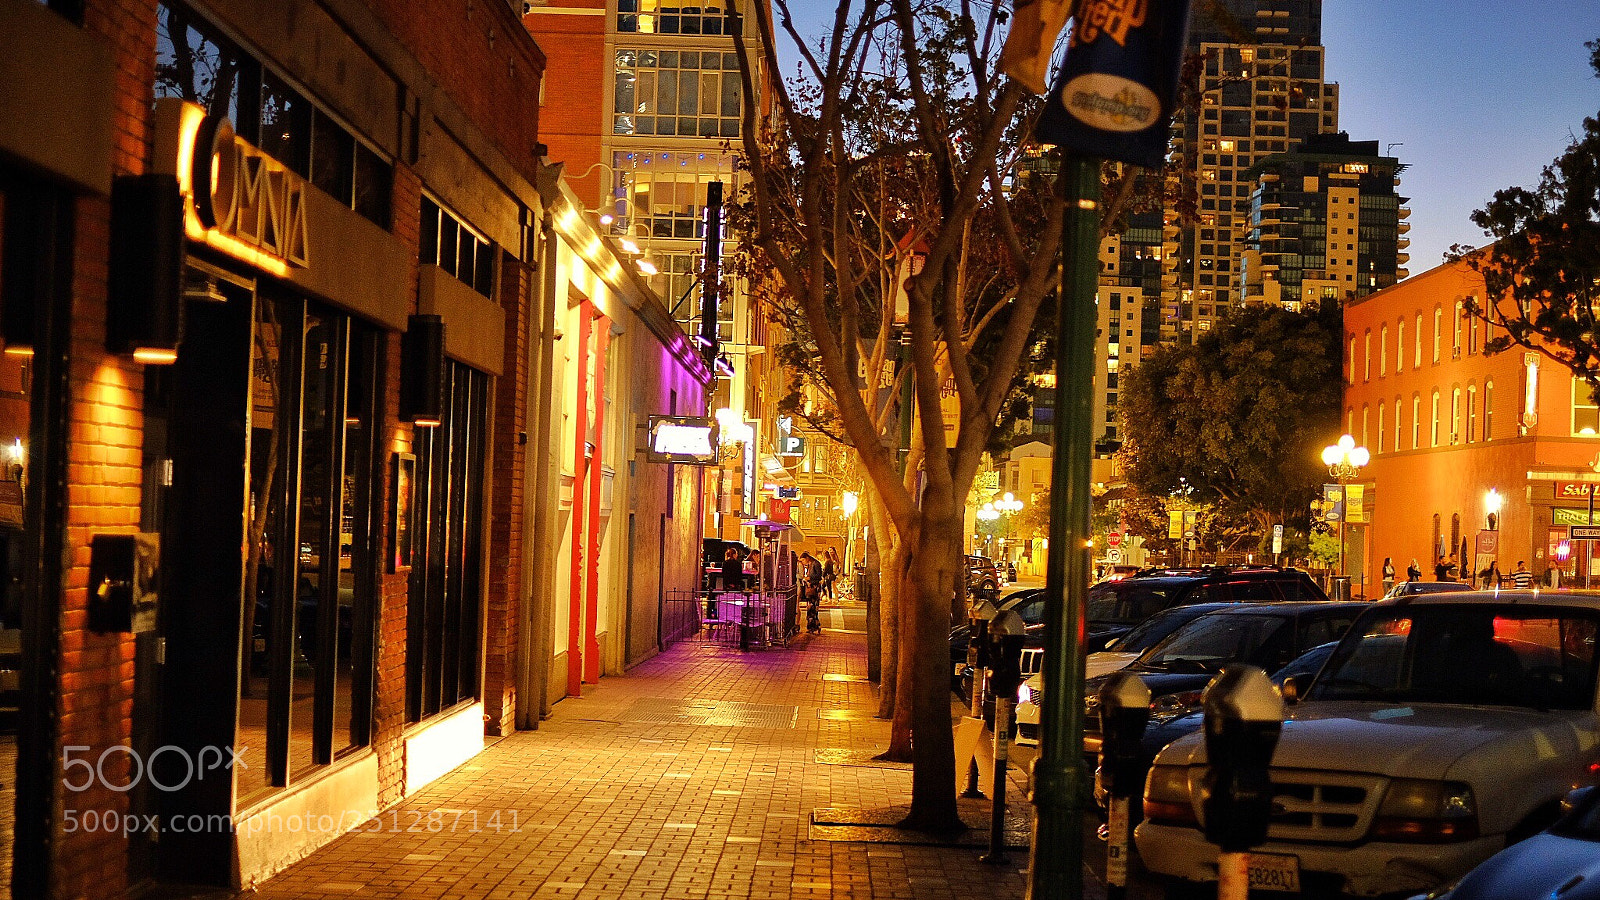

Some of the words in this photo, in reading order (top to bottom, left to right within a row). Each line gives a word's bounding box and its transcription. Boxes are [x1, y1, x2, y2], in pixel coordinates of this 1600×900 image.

[193, 116, 310, 268] OMNIA
[787, 437, 800, 453] P
[1562, 484, 1590, 496] Sab
